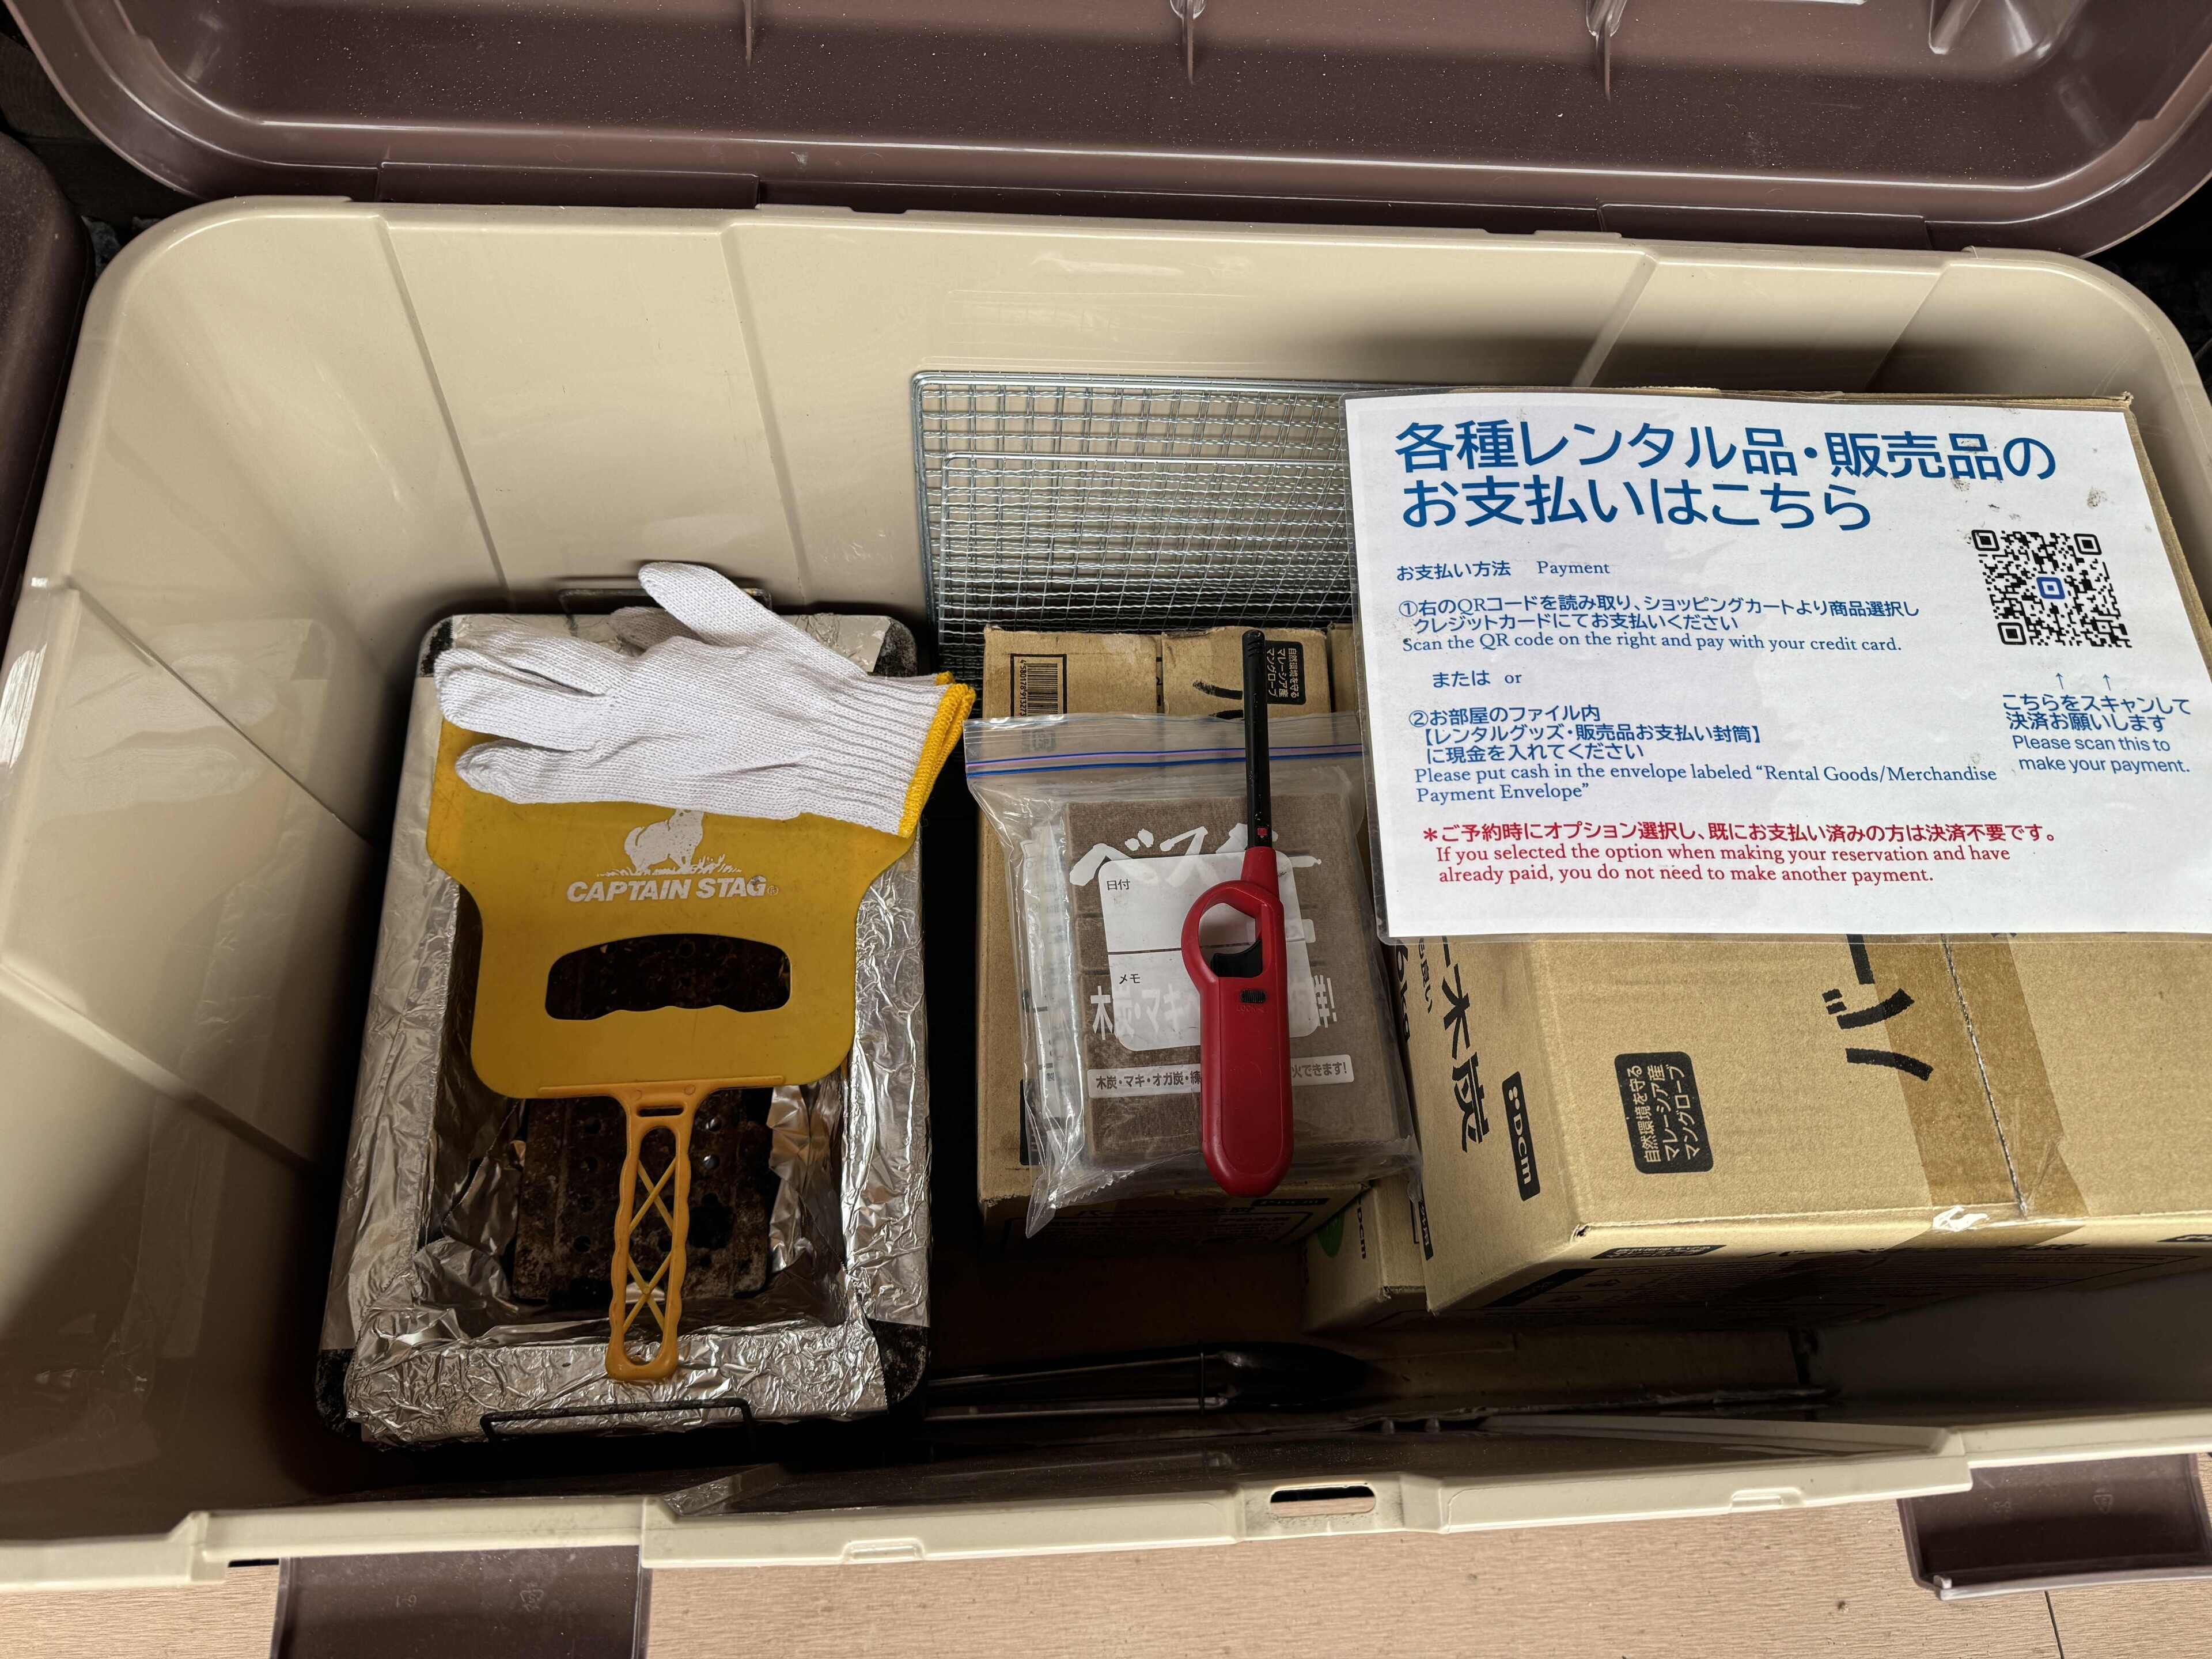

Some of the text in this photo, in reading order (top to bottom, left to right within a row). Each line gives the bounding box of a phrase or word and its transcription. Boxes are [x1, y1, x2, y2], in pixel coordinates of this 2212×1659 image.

[1395, 418, 2056, 481] 各種レンタル品・販売品の
[1403, 474, 1871, 531] お支払いはこちら
[1396, 560, 1611, 581] お支払い方法 Payment
[1398, 593, 1921, 618] ①右のQRコードを読み取り、ショッピングカートより商品選択し
[1412, 612, 1739, 635] クレジットカードにてお支払いください
[1402, 631, 1902, 653] Scan the QR code on the right and pay with your credit card.
[1267, 647, 1278, 698] マングローブ
[1277, 647, 1289, 698] マレーシア産
[1432, 669, 1522, 688] または or
[1408, 703, 1601, 728] ②お部屋のファイル内
[2002, 693, 2192, 715] こちらをスキャンして
[2005, 711, 2166, 733] 決済お願いします
[1425, 723, 1761, 747] 【レンタルグッズ・販売品お支払い封筒】
[2012, 734, 2171, 752] Please scan this to
[1427, 742, 1644, 765] に現金を入れてください
[1414, 767, 1471, 783] Please
[1475, 768, 1506, 784] put
[1511, 763, 1550, 779] cash
[1554, 763, 1572, 778] in
[1577, 762, 1605, 778] the
[1610, 763, 1687, 782] envelope
[1690, 763, 1753, 779] labeled
[1823, 764, 1997, 783] Goods/Merchandise
[2018, 756, 2190, 775] make your payment.
[1416, 787, 1496, 806] Payment
[1435, 842, 2011, 866] If you selected the option when making your reservation and have
[1107, 878, 1131, 891] 日付
[1439, 863, 1934, 886] already paid, you do not need to make another payment.
[566, 877, 691, 903] CAPTAIN
[1119, 973, 1141, 985] メモ
[1627, 1065, 1661, 1162] 自然環境を守る
[1647, 1063, 1679, 1162] マレーシア産
[1666, 1065, 1701, 1160] マングローブ
